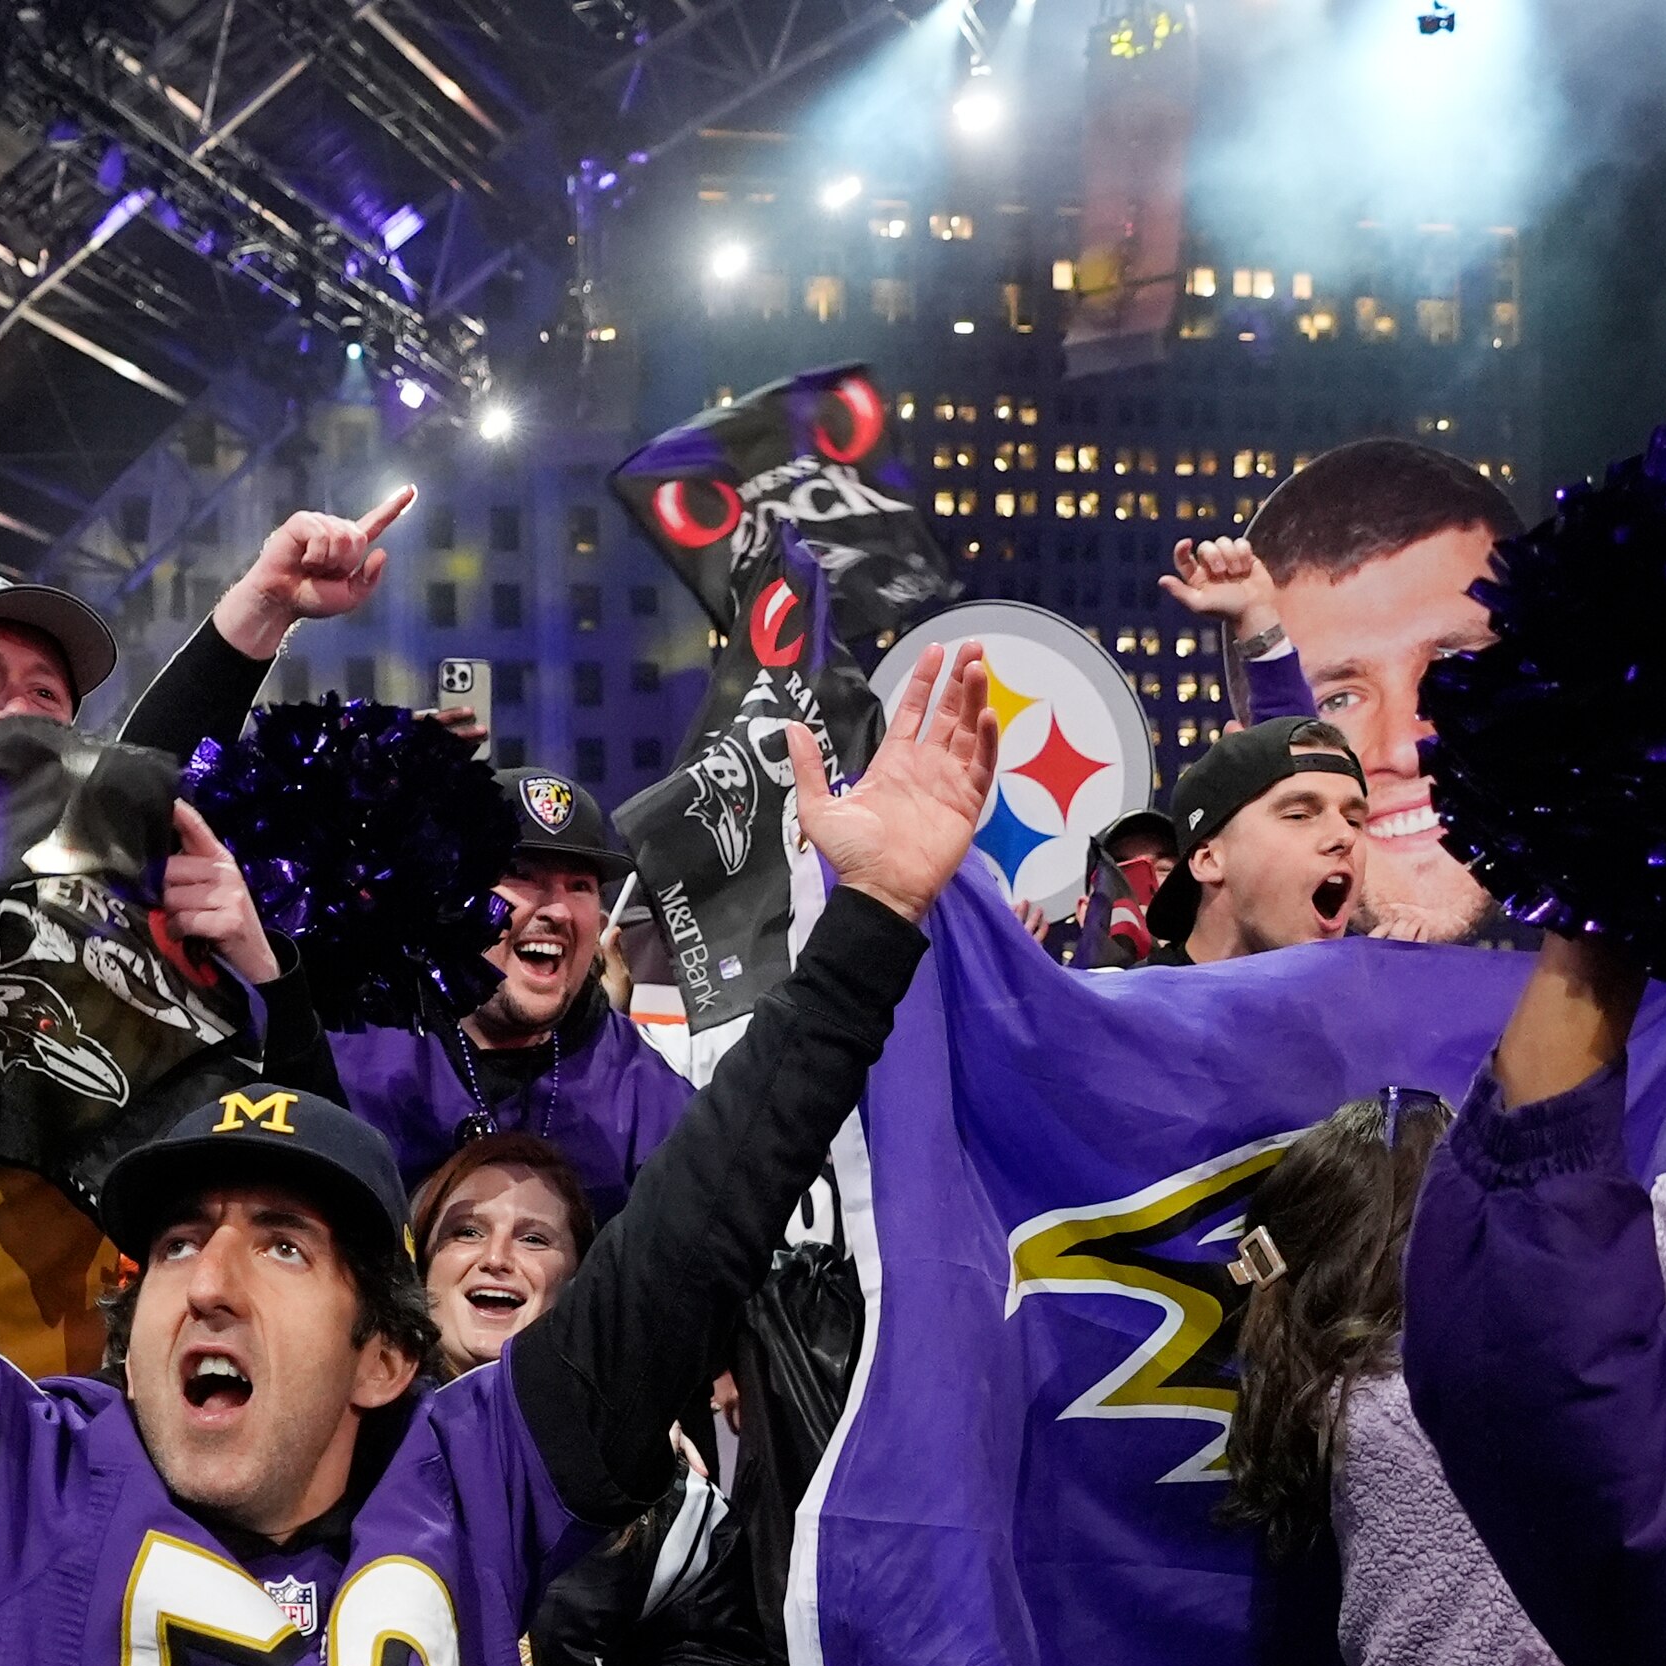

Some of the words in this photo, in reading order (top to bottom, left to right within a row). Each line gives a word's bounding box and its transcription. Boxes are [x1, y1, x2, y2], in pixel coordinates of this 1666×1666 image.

[657, 879, 703, 944] M&T
[680, 943, 721, 1012] Bank
[212, 1091, 299, 1134] M
